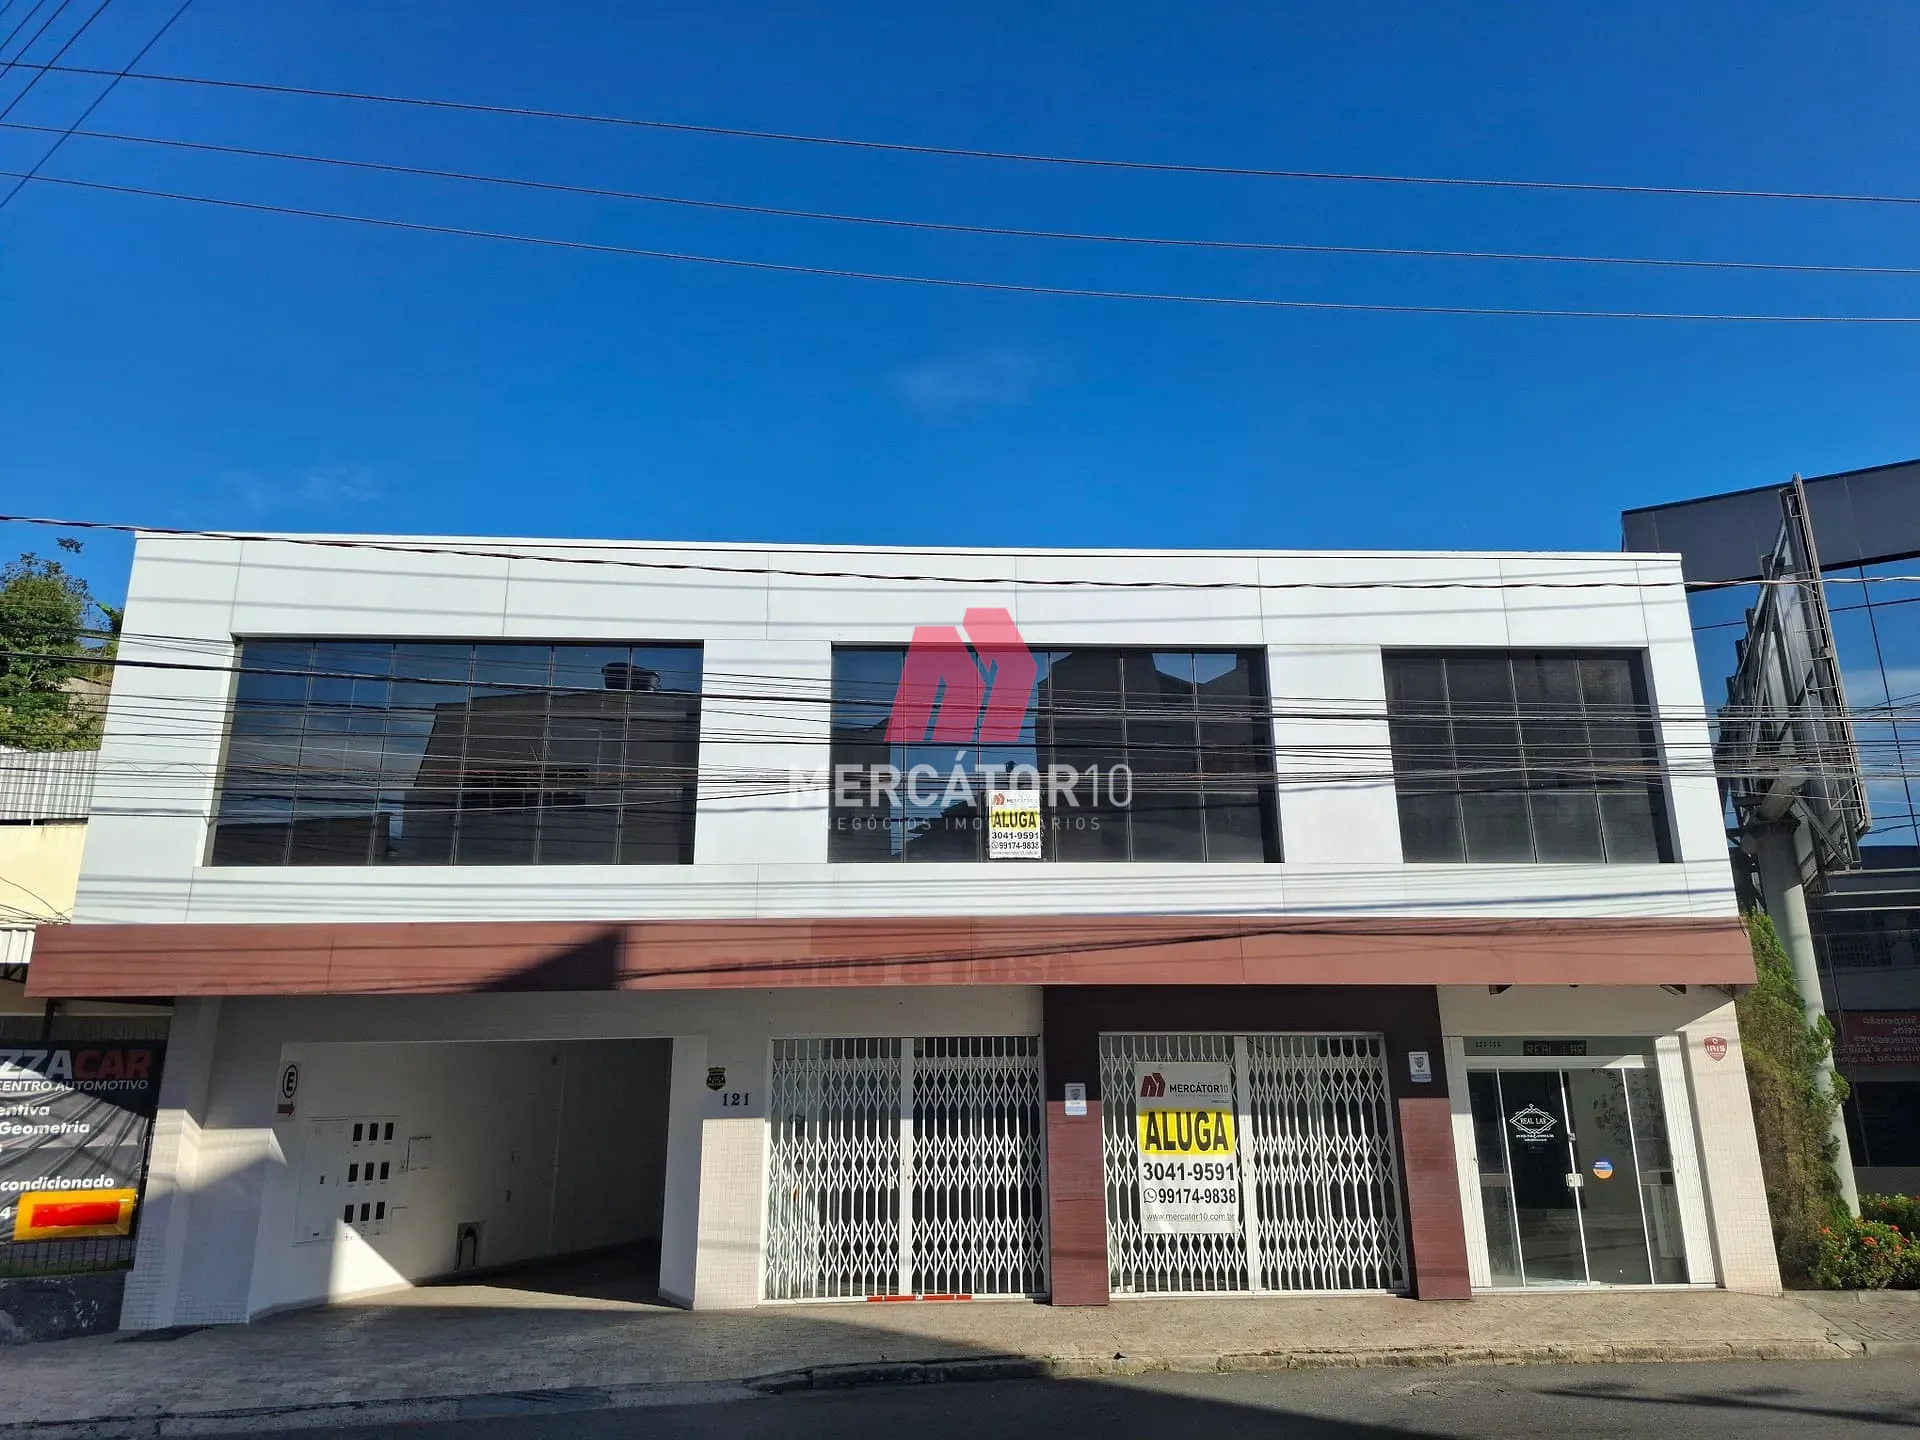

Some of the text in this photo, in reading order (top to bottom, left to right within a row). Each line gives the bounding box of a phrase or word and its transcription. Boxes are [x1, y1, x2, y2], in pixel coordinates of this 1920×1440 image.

[992, 811, 1037, 828] ALUGA
[991, 831, 1039, 840] 3041-9591
[55, 1079, 149, 1092] AUTOMOTIVO
[286, 1072, 295, 1091] E
[1169, 1081, 1229, 1093] MERCÁTOR10
[722, 1092, 750, 1106] 121
[0, 1120, 90, 1135] Geometria
[1145, 1111, 1229, 1152] ALUGA
[1143, 1162, 1235, 1181] 3041-9591
[1, 1174, 115, 1191] condicionado
[1158, 1187, 1236, 1204] 99174-9838
